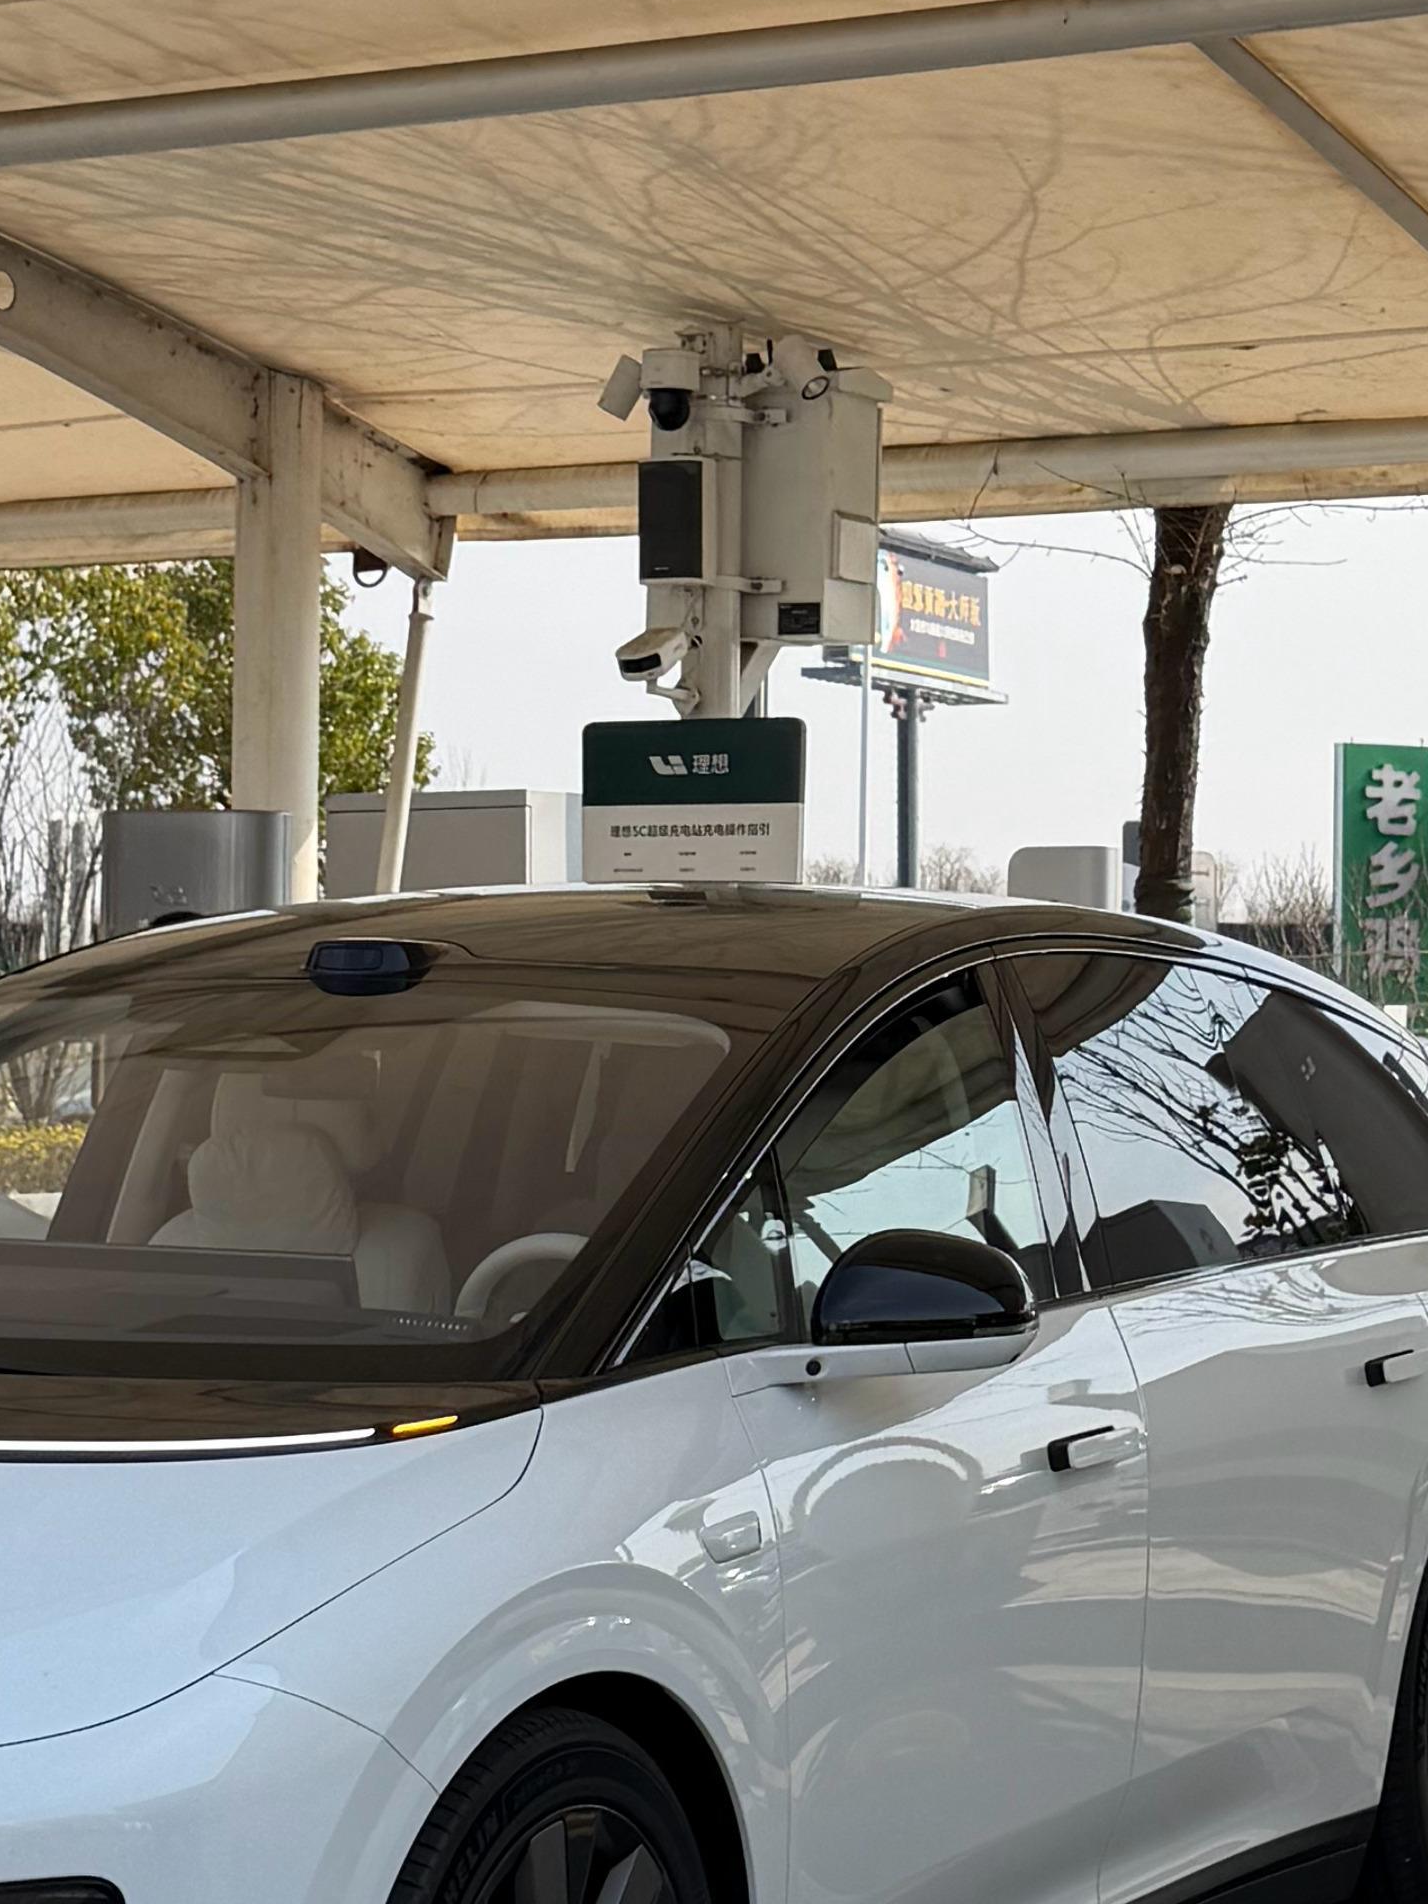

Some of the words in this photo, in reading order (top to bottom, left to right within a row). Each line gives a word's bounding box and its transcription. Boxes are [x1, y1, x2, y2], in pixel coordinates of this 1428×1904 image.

[692, 753, 730, 775] 理想
[610, 822, 770, 838] 理想5C超级充电站充电操作指引
[1364, 763, 1421, 984] 老乡鸡
